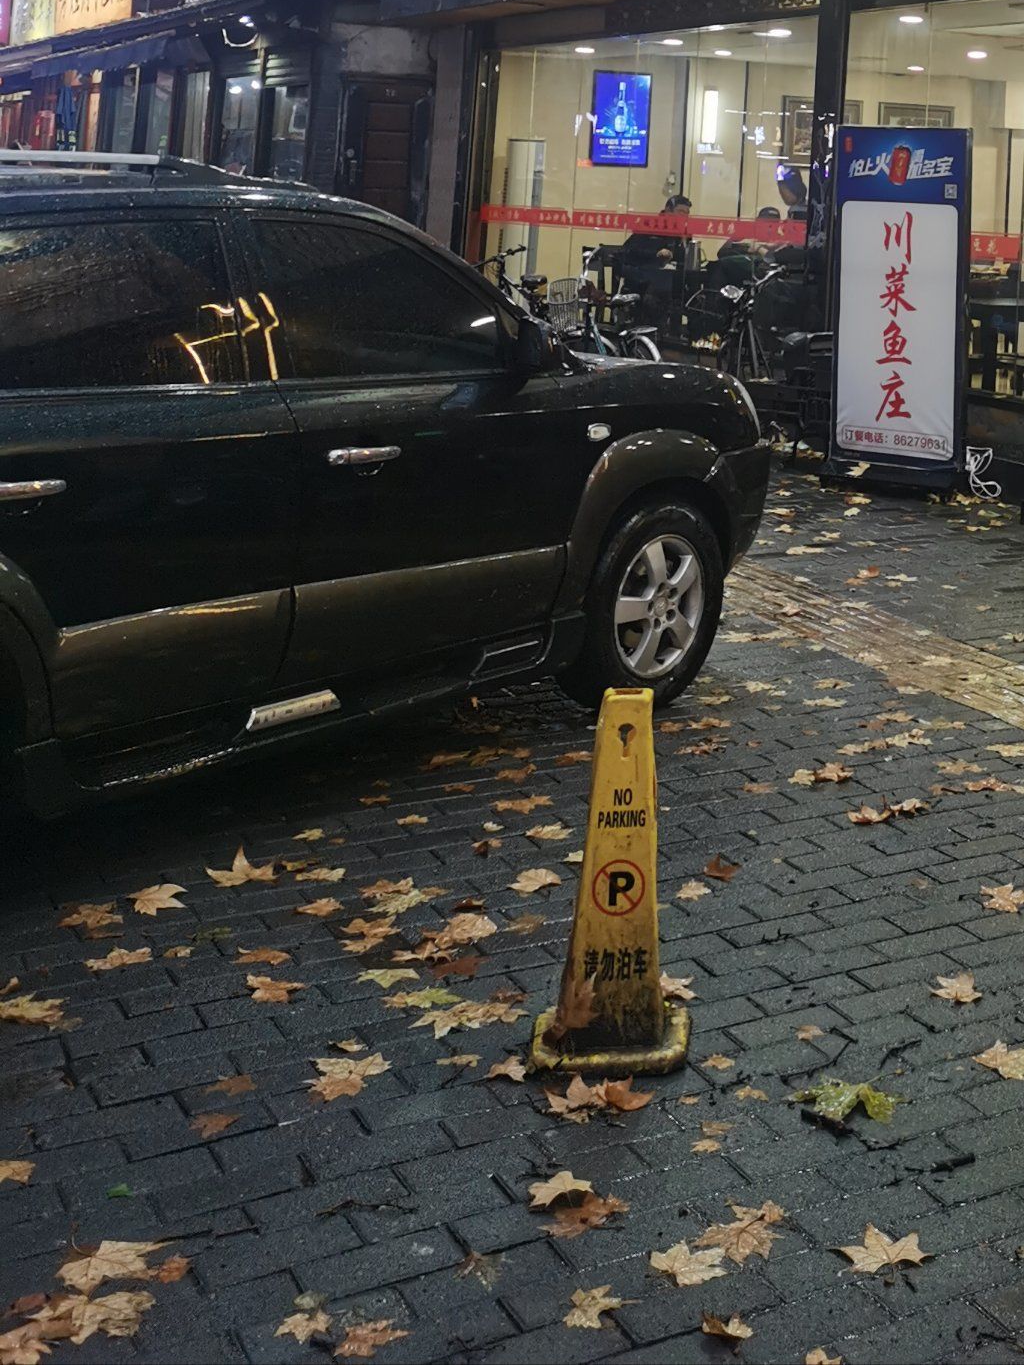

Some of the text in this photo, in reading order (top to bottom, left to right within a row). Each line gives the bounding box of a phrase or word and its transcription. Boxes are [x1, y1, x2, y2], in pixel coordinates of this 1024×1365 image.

[848, 152, 891, 178] 怕上火
[874, 210, 917, 423] 川菜鱼庄
[893, 434, 946, 451] 86279631
[613, 788, 633, 807] NO
[598, 809, 646, 829] PARKING
[584, 946, 648, 982] 请勿泊车
